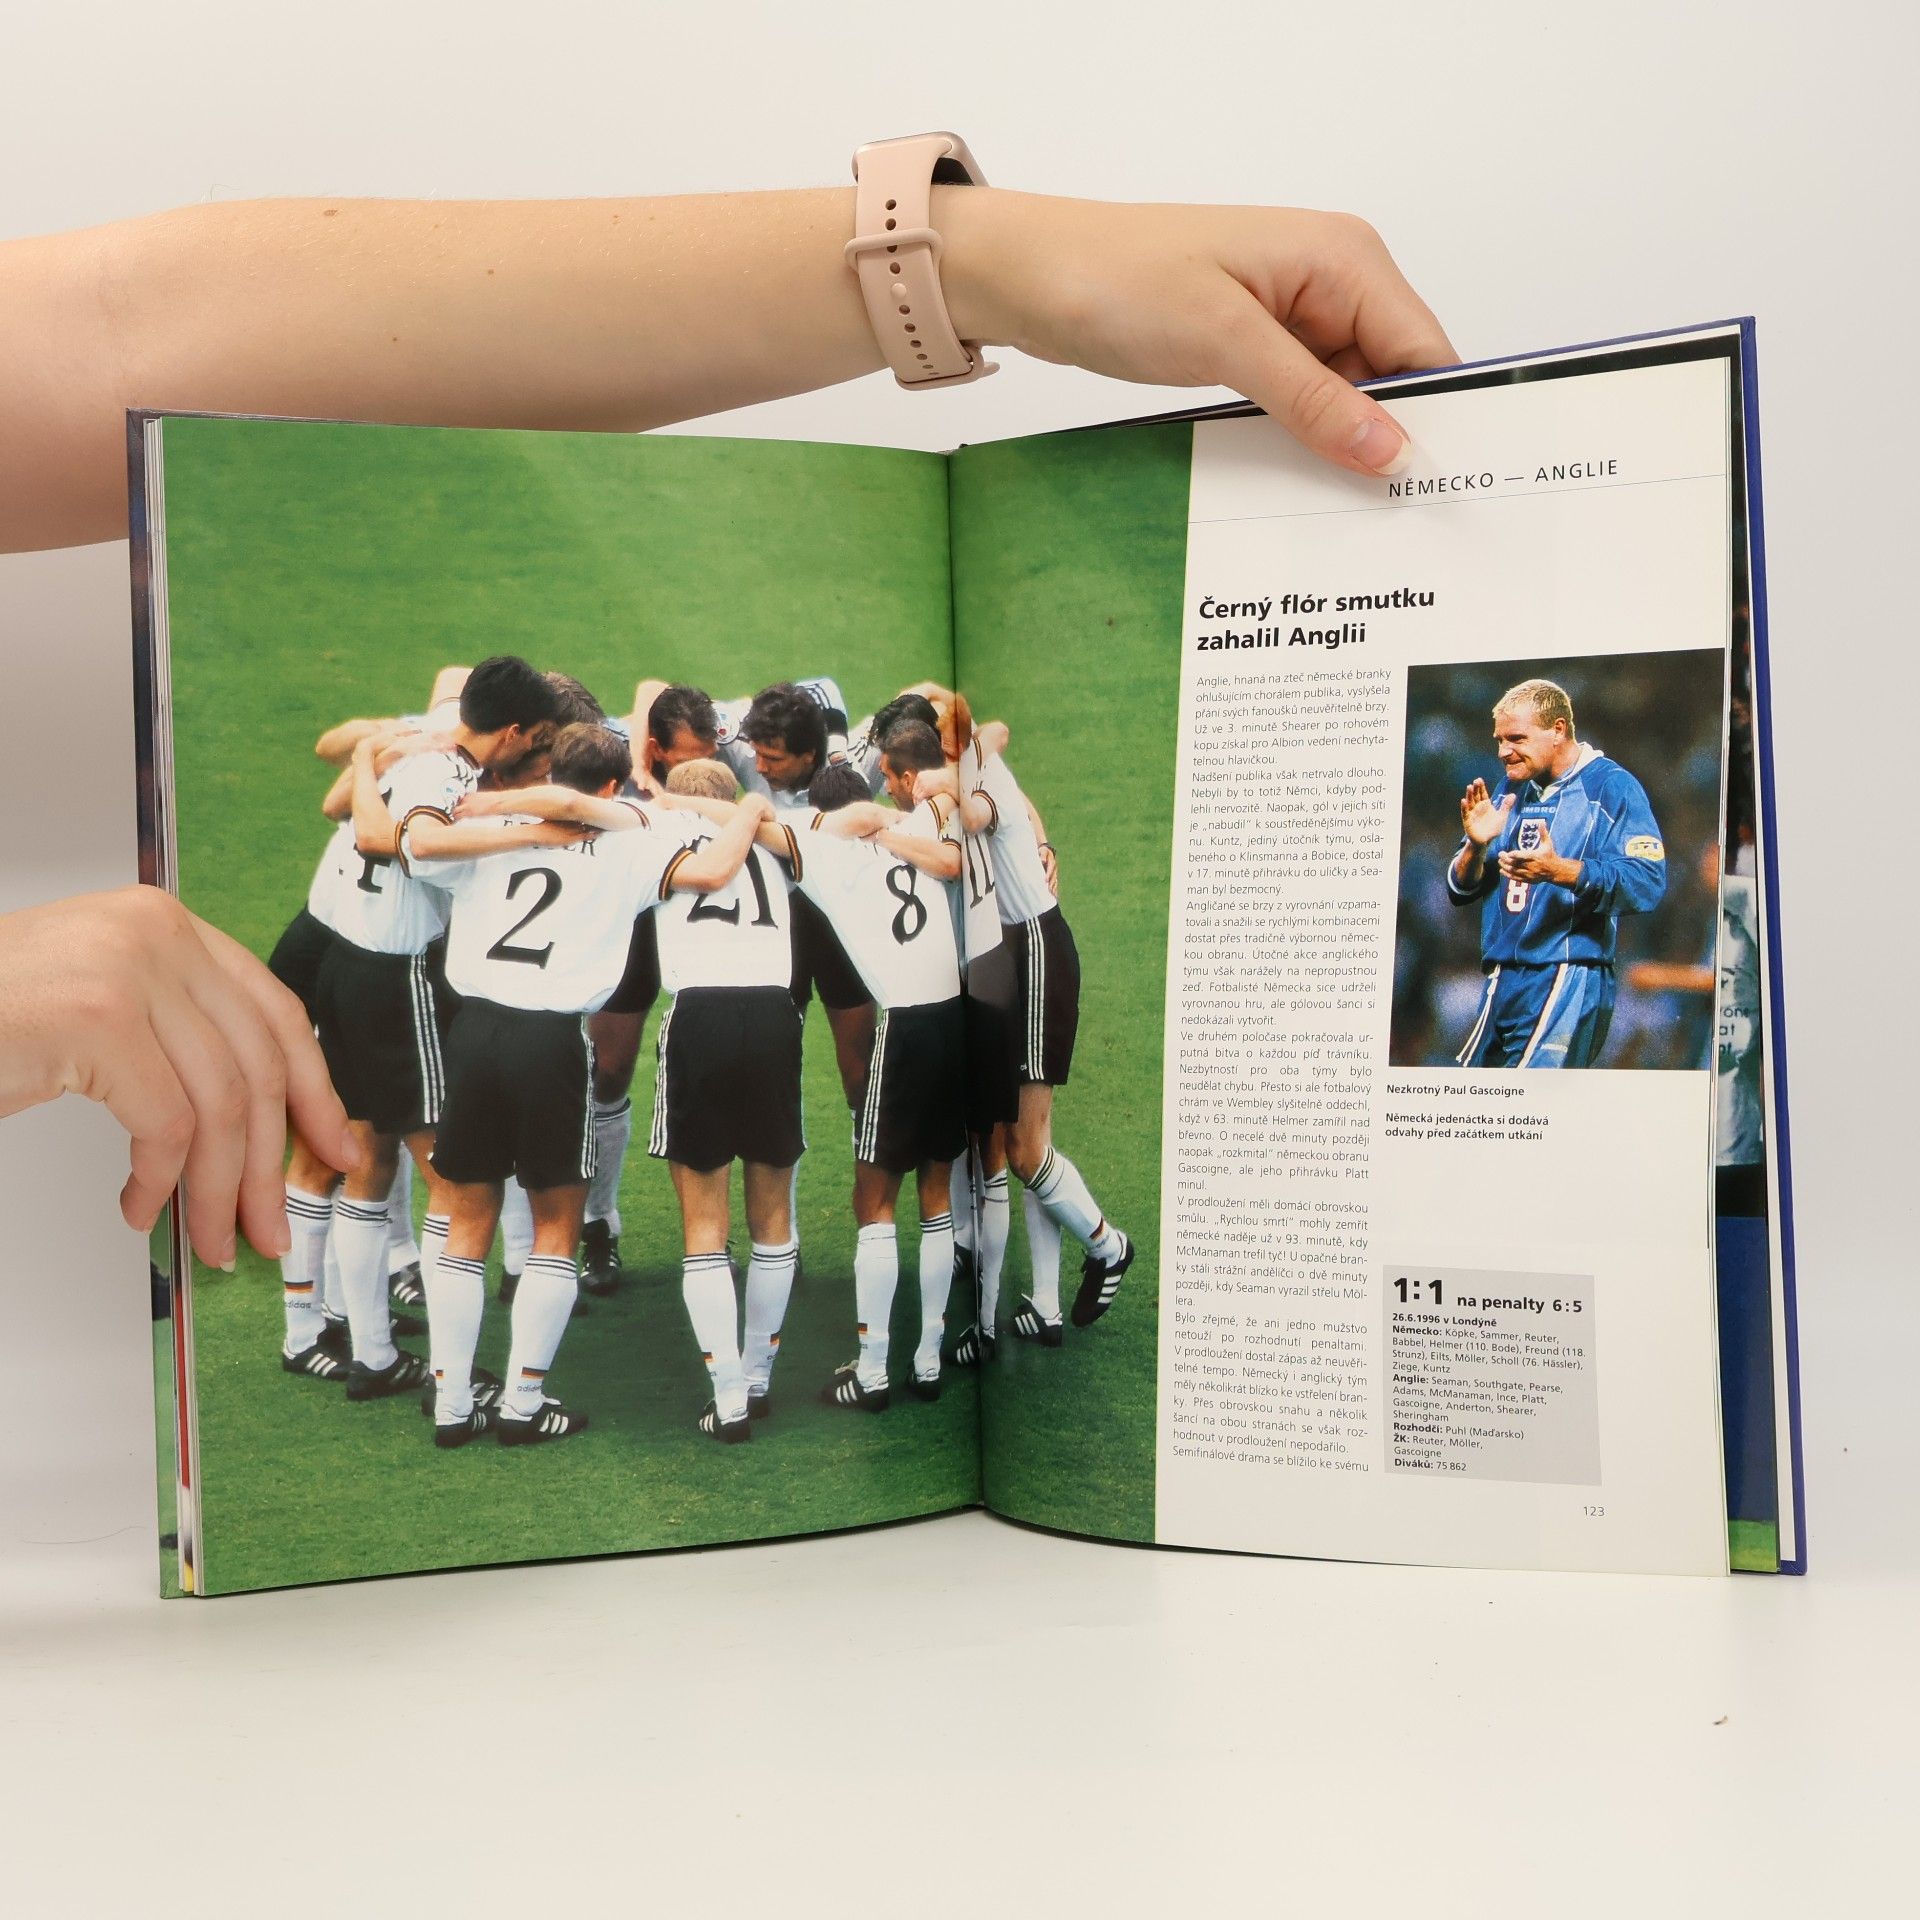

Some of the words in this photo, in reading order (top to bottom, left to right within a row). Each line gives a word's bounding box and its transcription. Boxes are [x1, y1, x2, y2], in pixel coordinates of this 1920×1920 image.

[1389, 473, 1494, 497] NĚMECKO
[1535, 460, 1618, 482] ANGLIE
[1200, 596, 1272, 621] Černý
[1280, 594, 1327, 614] flór
[1335, 588, 1435, 612] smutku
[1197, 627, 1279, 650] zahalil
[1289, 623, 1366, 647] Anglii
[1234, 673, 1266, 685] hnaná
[1268, 675, 1281, 684] na
[1283, 671, 1305, 683] zteč
[1307, 670, 1353, 682] německé
[1356, 668, 1392, 683] branky
[1195, 723, 1208, 734] Už
[1212, 725, 1223, 734] ve
[1242, 720, 1278, 733] minutě
[1282, 719, 1321, 731] Shearer
[1325, 721, 1339, 732] po
[1343, 716, 1389, 729] rohovém
[1191, 786, 1222, 800] Nebyli
[1226, 786, 1239, 800] by
[1244, 785, 1254, 797] to
[1259, 785, 1281, 796] totiž
[1326, 783, 1357, 797] kdyby
[1248, 834, 1278, 848] jediný
[1283, 833, 1320, 845] útočník
[885, 864, 927, 946] 8
[1186, 899, 1236, 913] Angličané
[1238, 902, 1250, 910] se
[1252, 899, 1274, 912] brzy
[1277, 901, 1283, 910] z
[1285, 898, 1335, 912] vyrovnání
[486, 867, 562, 969] 2
[1184, 948, 1203, 959] kou
[1252, 945, 1289, 959] Útočné
[1293, 948, 1318, 959] akce
[1322, 948, 1379, 961] anglického
[1209, 981, 1259, 992] Fotbalisté
[1263, 981, 1311, 992] Německa
[1316, 981, 1336, 992] sice
[1341, 981, 1376, 992] udrželi
[1180, 1029, 1194, 1041] Ve
[1197, 1030, 1237, 1041] druhém
[1242, 1030, 1287, 1044] poločase
[1291, 1031, 1354, 1045] pokračovala
[1180, 1063, 1238, 1077] Nezbytností
[1250, 1066, 1268, 1077] pro
[1280, 1064, 1299, 1076] oba
[1312, 1064, 1338, 1078] týmy
[1350, 1065, 1372, 1079] bylo
[1387, 1084, 1441, 1096] Nezkrotný
[1444, 1085, 1466, 1095] Paul
[1469, 1085, 1525, 1098] Gascoigne
[1386, 1113, 1433, 1123] Německá
[1436, 1114, 1494, 1126] jedenáctka
[1497, 1115, 1505, 1125] si
[1508, 1115, 1549, 1126] dodává
[1219, 1130, 1228, 1141] O
[1232, 1130, 1265, 1142] necelé
[1269, 1131, 1287, 1142] dvě
[1292, 1131, 1328, 1146] minuty
[1332, 1132, 1370, 1146] později
[1385, 1127, 1424, 1139] odvahy
[1427, 1128, 1451, 1140] před
[1454, 1129, 1505, 1139] začátkem
[1508, 1130, 1542, 1140] utkání
[1238, 1164, 1254, 1175] ale
[1260, 1164, 1283, 1179] jeho
[1289, 1165, 1338, 1180] přihrávku
[1345, 1167, 1369, 1179] Platt
[1176, 1228, 1220, 1241] německé
[1223, 1230, 1257, 1245] naděje
[1260, 1232, 1272, 1244] už
[1275, 1235, 1282, 1244] v
[1349, 1236, 1368, 1250] kdy
[1393, 1278, 1442, 1305] 1:1
[1457, 1295, 1476, 1307] na
[1482, 1296, 1545, 1314] penalty
[1175, 1311, 1196, 1326] Bylo
[1246, 1315, 1257, 1327] že
[1264, 1316, 1280, 1328] ani
[1287, 1318, 1316, 1333] jedno
[1323, 1320, 1368, 1334] mužstvo
[1392, 1312, 1441, 1324] 26.6.1996
[1452, 1315, 1497, 1329] Londýně
[1392, 1324, 1442, 1336] Německo:
[1445, 1327, 1477, 1340] Köpke,
[1480, 1329, 1522, 1342] Sammer,
[1524, 1331, 1559, 1344] Reuter,
[1392, 1336, 1426, 1350] Babbel,
[1429, 1339, 1463, 1350] Helmer
[1465, 1341, 1489, 1353] (110.
[1491, 1342, 1522, 1355] Bode),
[1525, 1344, 1559, 1356] Freund
[1562, 1347, 1586, 1359] (118.
[1392, 1348, 1428, 1361] Strunz),
[1430, 1351, 1452, 1363] Eilts,
[1454, 1352, 1488, 1365] Möller,
[1491, 1354, 1519, 1365] Scholl
[1521, 1356, 1540, 1368] (76.
[1542, 1357, 1583, 1371] Hässler),
[1392, 1361, 1420, 1373] Ziege,
[1423, 1362, 1451, 1373] Kuntz
[1174, 1361, 1198, 1373] telné
[1242, 1365, 1288, 1382] Německý
[1293, 1369, 1296, 1380] i
[1300, 1369, 1343, 1386] anglický
[1347, 1373, 1367, 1388] tým
[1392, 1373, 1429, 1386] Anglie:
[1431, 1376, 1471, 1389] Seaman,
[1473, 1378, 1526, 1392] Southgate,
[1529, 1382, 1563, 1395] Pearse,
[1392, 1385, 1426, 1398] Adams,
[1429, 1387, 1494, 1403] McManaman,
[1496, 1392, 1519, 1404] Ince,
[1521, 1393, 1547, 1406] Platt,
[1392, 1397, 1443, 1412] Gascoigne,
[1445, 1401, 1494, 1415] Anderton,
[1496, 1404, 1537, 1418] Shearer,
[1392, 1409, 1449, 1424] Sheringham
[1393, 1421, 1443, 1433] Rozhodčí:
[1445, 1424, 1466, 1435] Puhl
[1469, 1426, 1524, 1440] (Maďarsko)
[1393, 1432, 1410, 1444] ŽK:
[1412, 1435, 1446, 1448] Reuter,
[1449, 1437, 1483, 1451] Möller,
[1393, 1445, 1442, 1459] Gascoigne
[1394, 1457, 1433, 1469] Diváků:
[1584, 1506, 1605, 1517] 123
